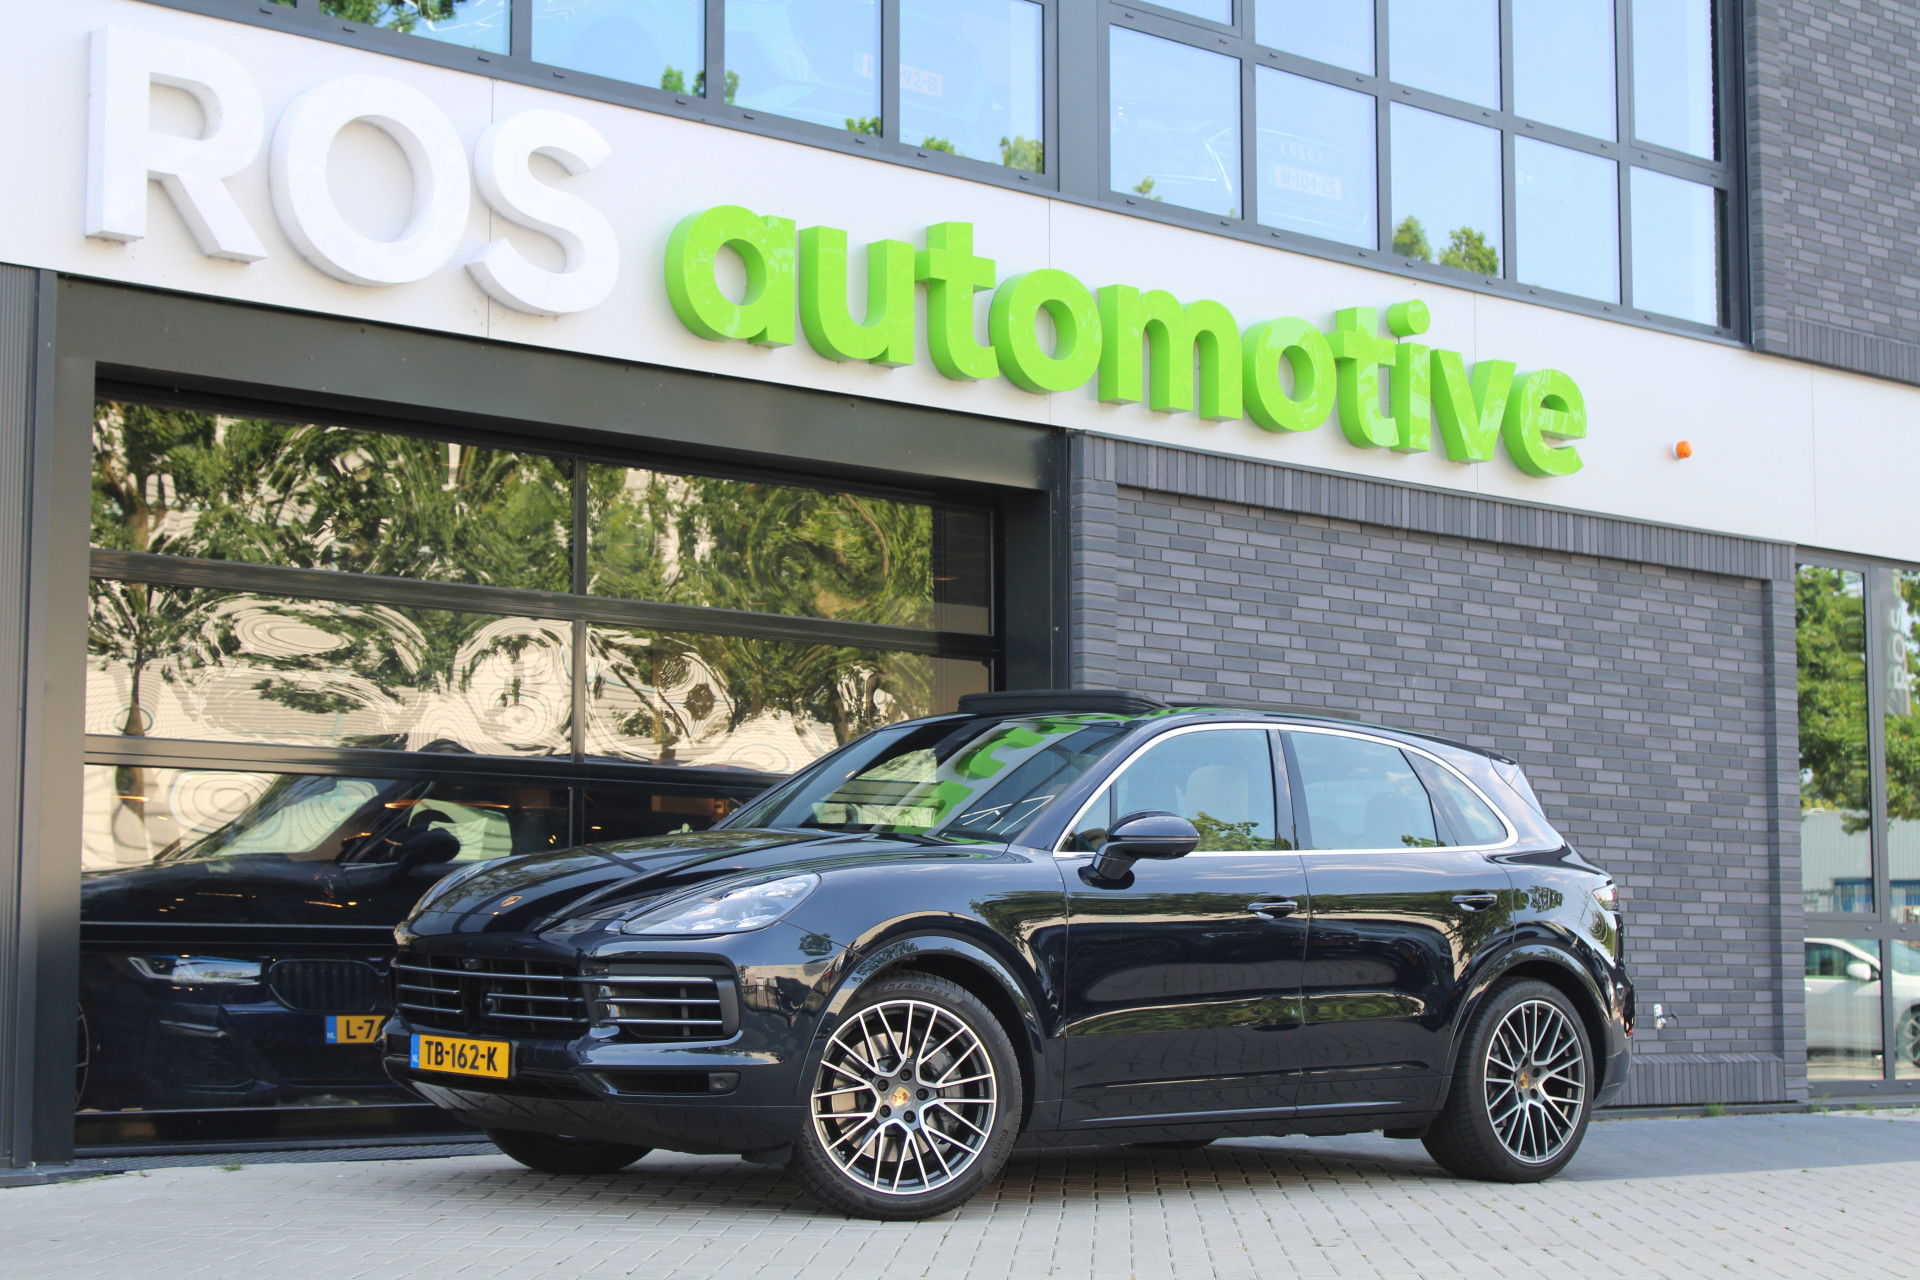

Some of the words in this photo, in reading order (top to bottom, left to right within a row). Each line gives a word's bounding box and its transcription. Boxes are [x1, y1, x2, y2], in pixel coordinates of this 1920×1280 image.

[85, 26, 620, 316] ROS
[665, 205, 1587, 478] automotive
[424, 1040, 498, 1072] TB-162-K
